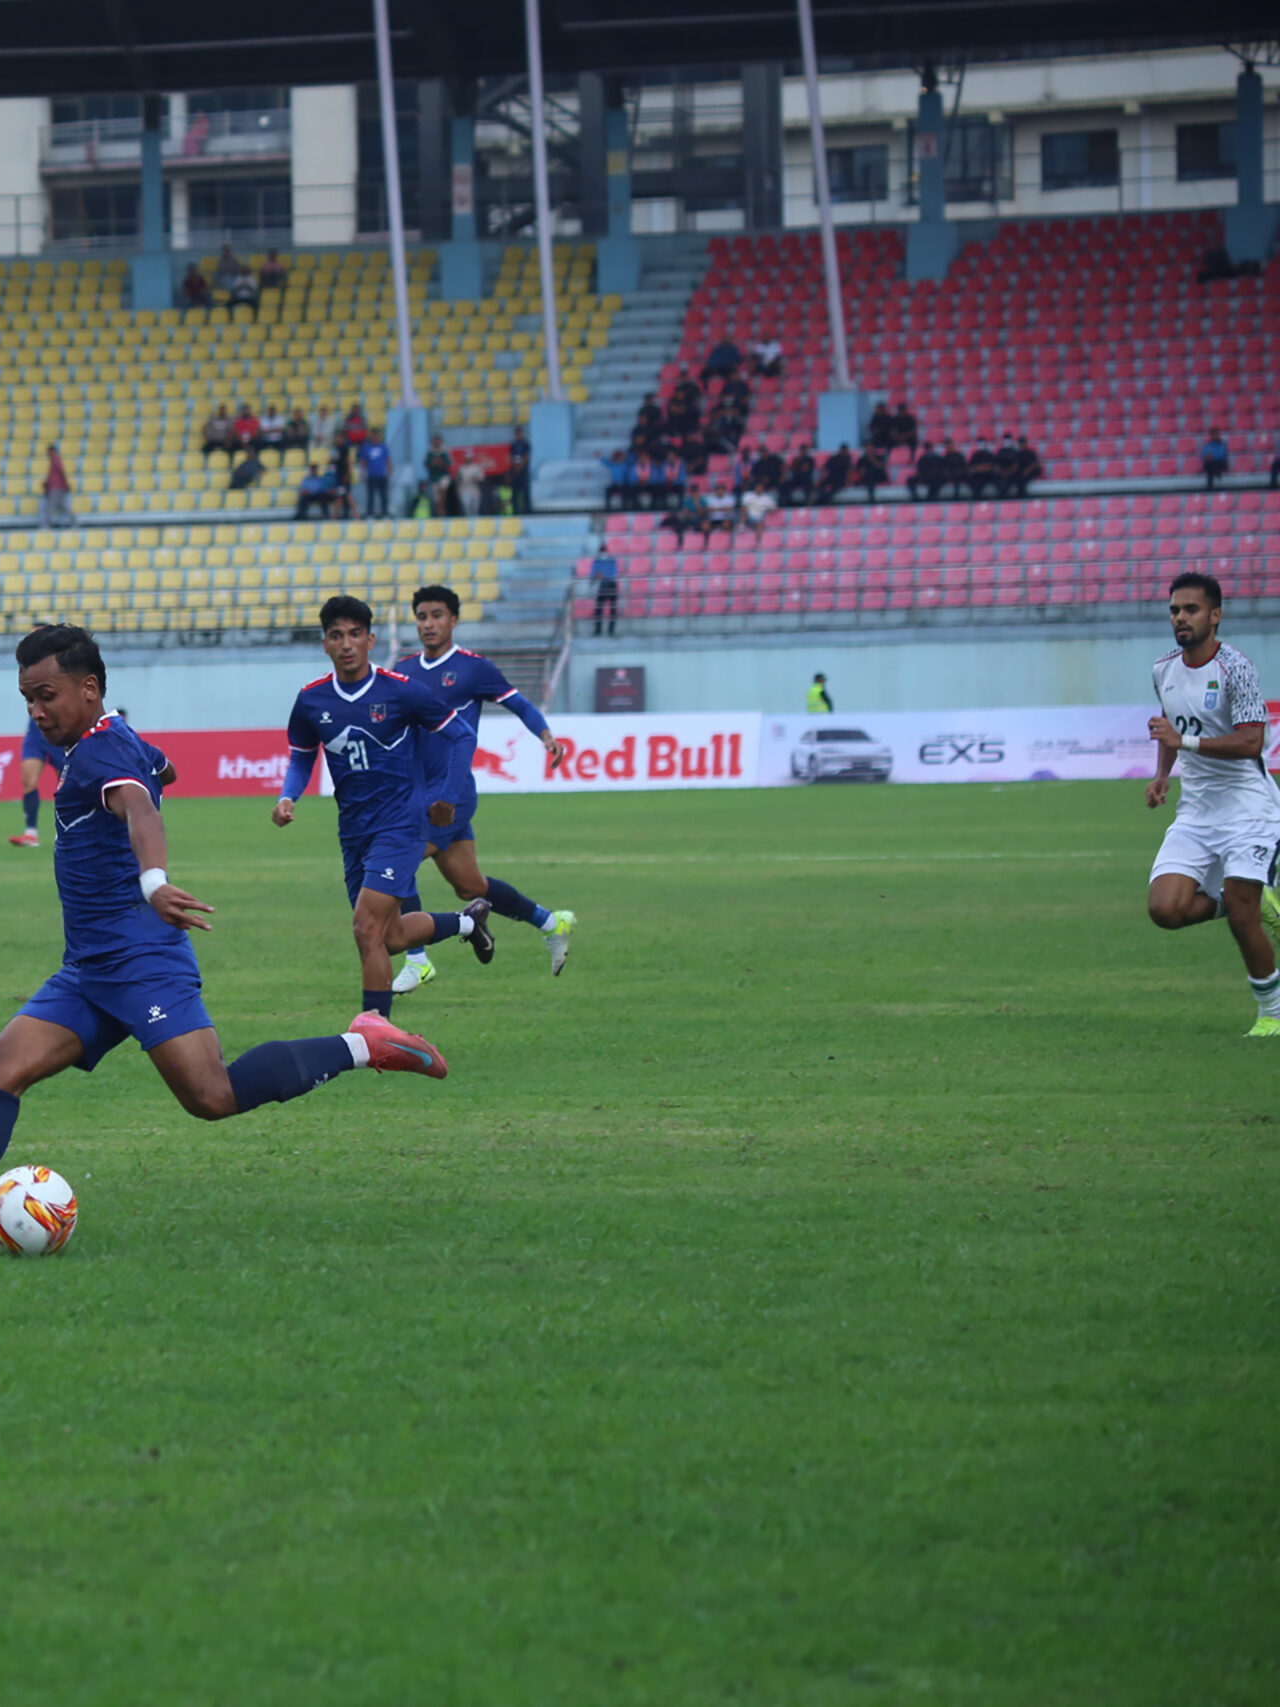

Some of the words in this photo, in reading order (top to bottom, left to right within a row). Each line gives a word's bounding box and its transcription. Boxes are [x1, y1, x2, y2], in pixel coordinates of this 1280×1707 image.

[347, 740, 369, 771] 21
[544, 736, 636, 780] Red
[647, 733, 742, 779] Bull
[919, 742, 1007, 765] EX5
[218, 754, 289, 779] khalt
[1252, 844, 1269, 862] 22
